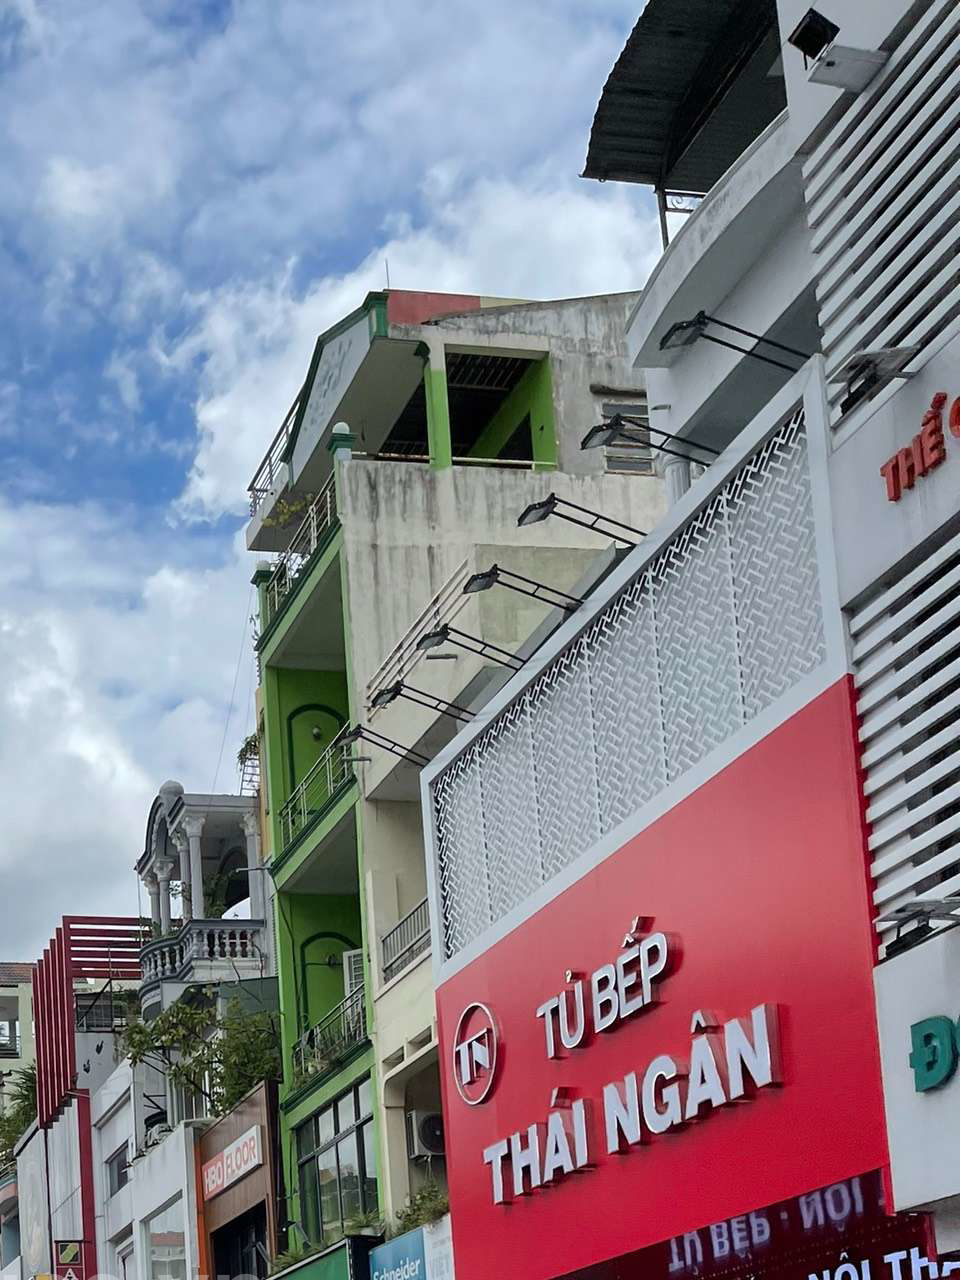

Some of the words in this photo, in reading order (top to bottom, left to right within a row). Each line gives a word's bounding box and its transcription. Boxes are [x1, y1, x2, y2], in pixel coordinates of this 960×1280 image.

[880, 392, 947, 502] THẾ
[536, 969, 587, 1059] TỦ
[592, 916, 672, 1034] BẾP
[483, 1088, 593, 1205] THÁI
[603, 1004, 780, 1156] NGÂN
[909, 1014, 960, 1094] Đ
